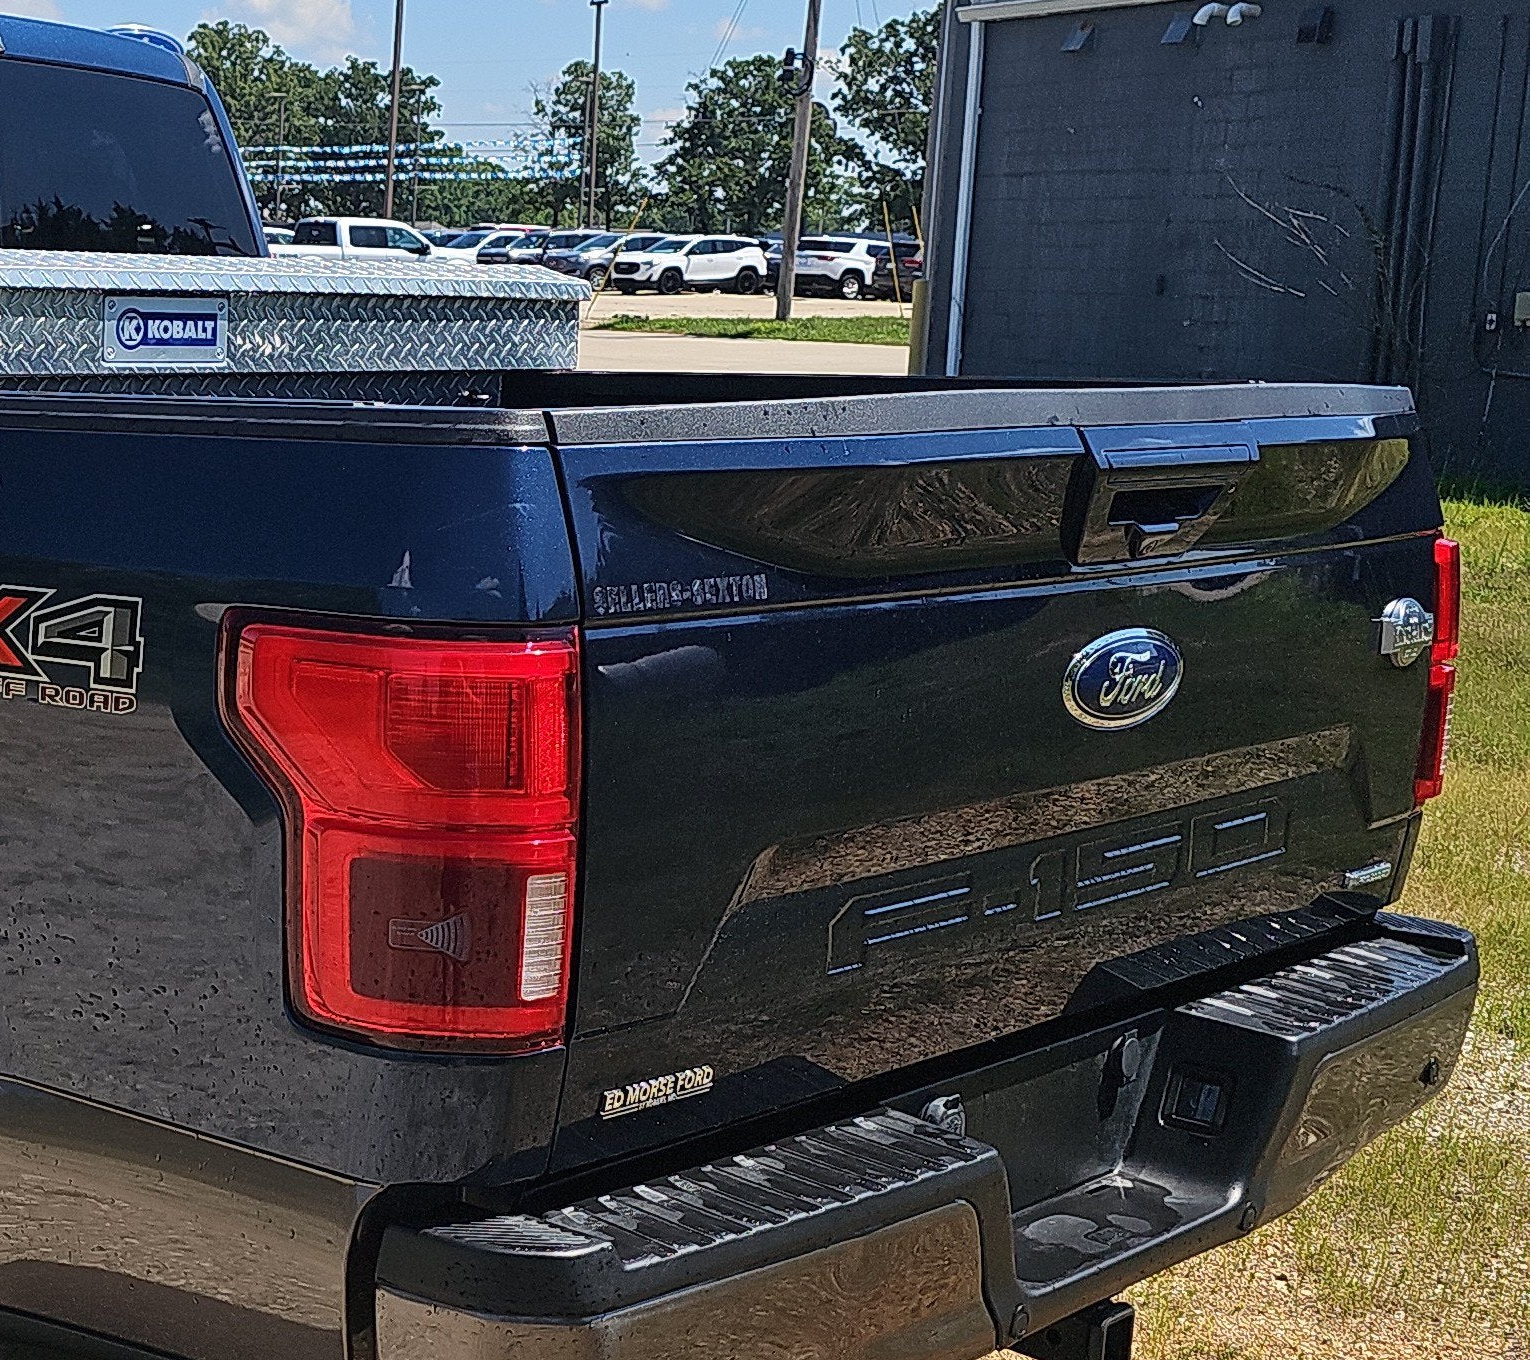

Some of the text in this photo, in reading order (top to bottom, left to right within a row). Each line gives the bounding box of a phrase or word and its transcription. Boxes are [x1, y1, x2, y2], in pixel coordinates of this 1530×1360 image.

[147, 319, 215, 340] KOBALT
[592, 573, 769, 616] SELLERS-SEXTON
[38, 682, 137, 715] ROAD
[1099, 650, 1166, 708] Ford
[826, 795, 1290, 976] F-150
[603, 1087, 625, 1112] ED
[625, 1074, 676, 1107] MORSE
[674, 1064, 715, 1095] FORD
